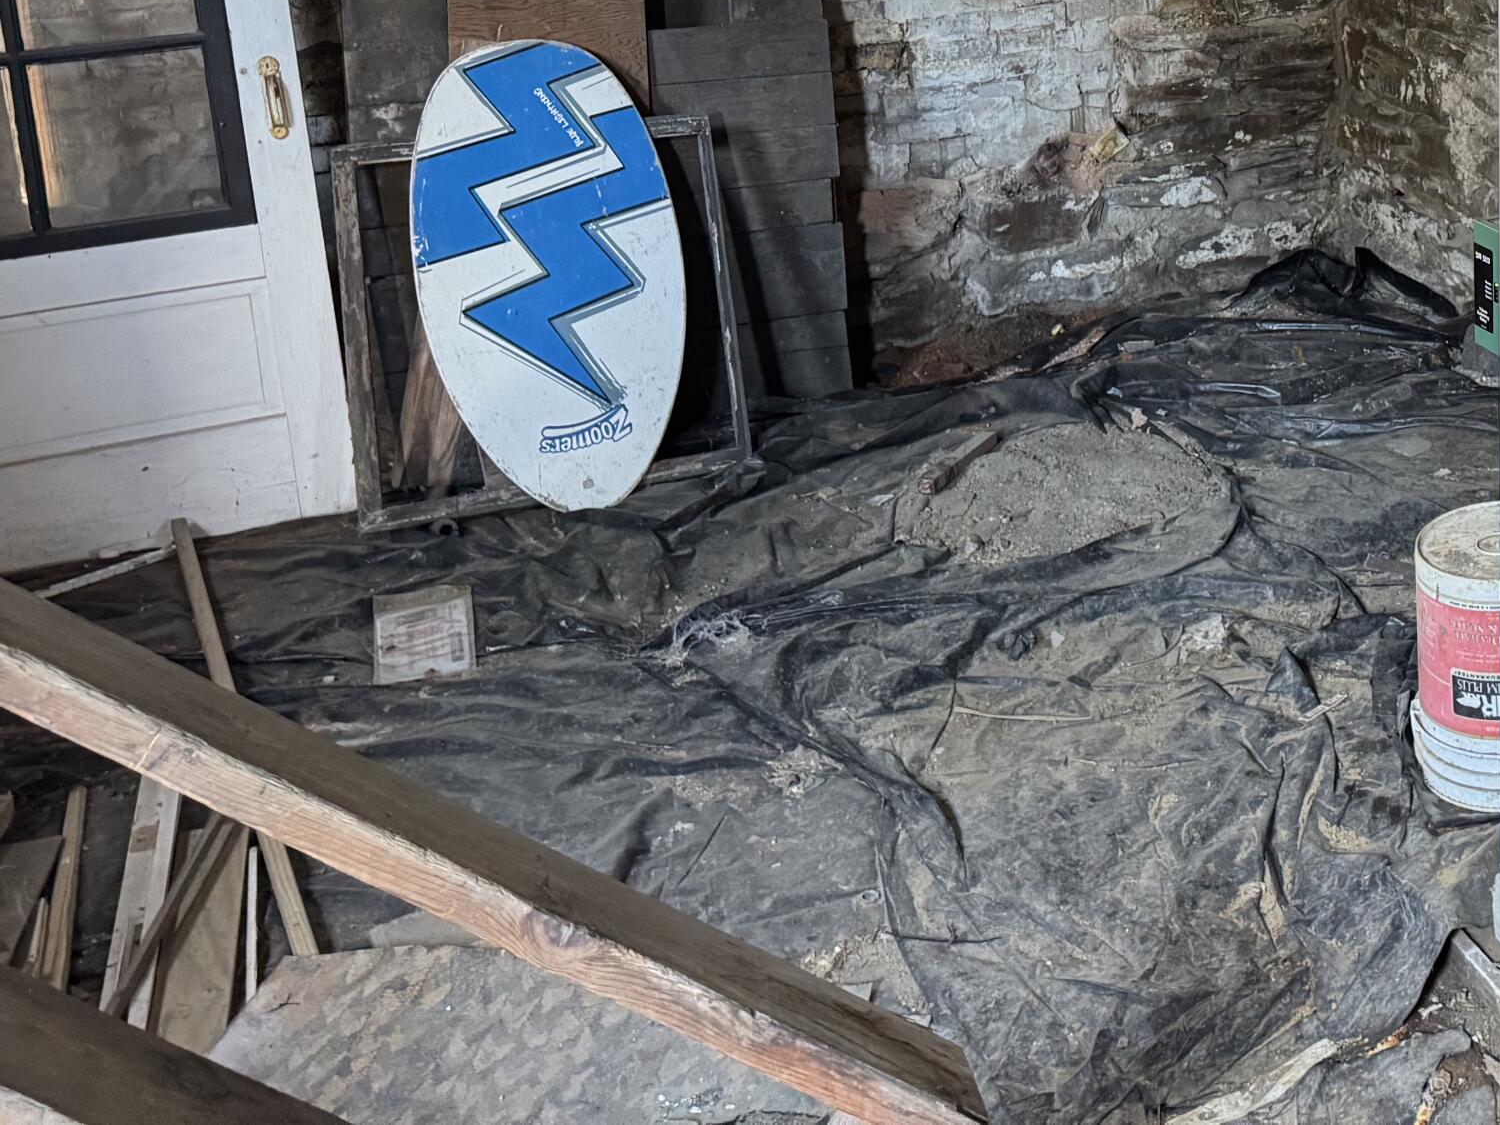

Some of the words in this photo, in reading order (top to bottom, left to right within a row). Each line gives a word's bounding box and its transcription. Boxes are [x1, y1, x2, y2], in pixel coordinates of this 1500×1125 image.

[534, 88, 568, 128] LIGHTNING
[566, 128, 584, 147] BLUE
[539, 403, 632, 454] Zoomers
[1458, 679, 1482, 693] PLUS
